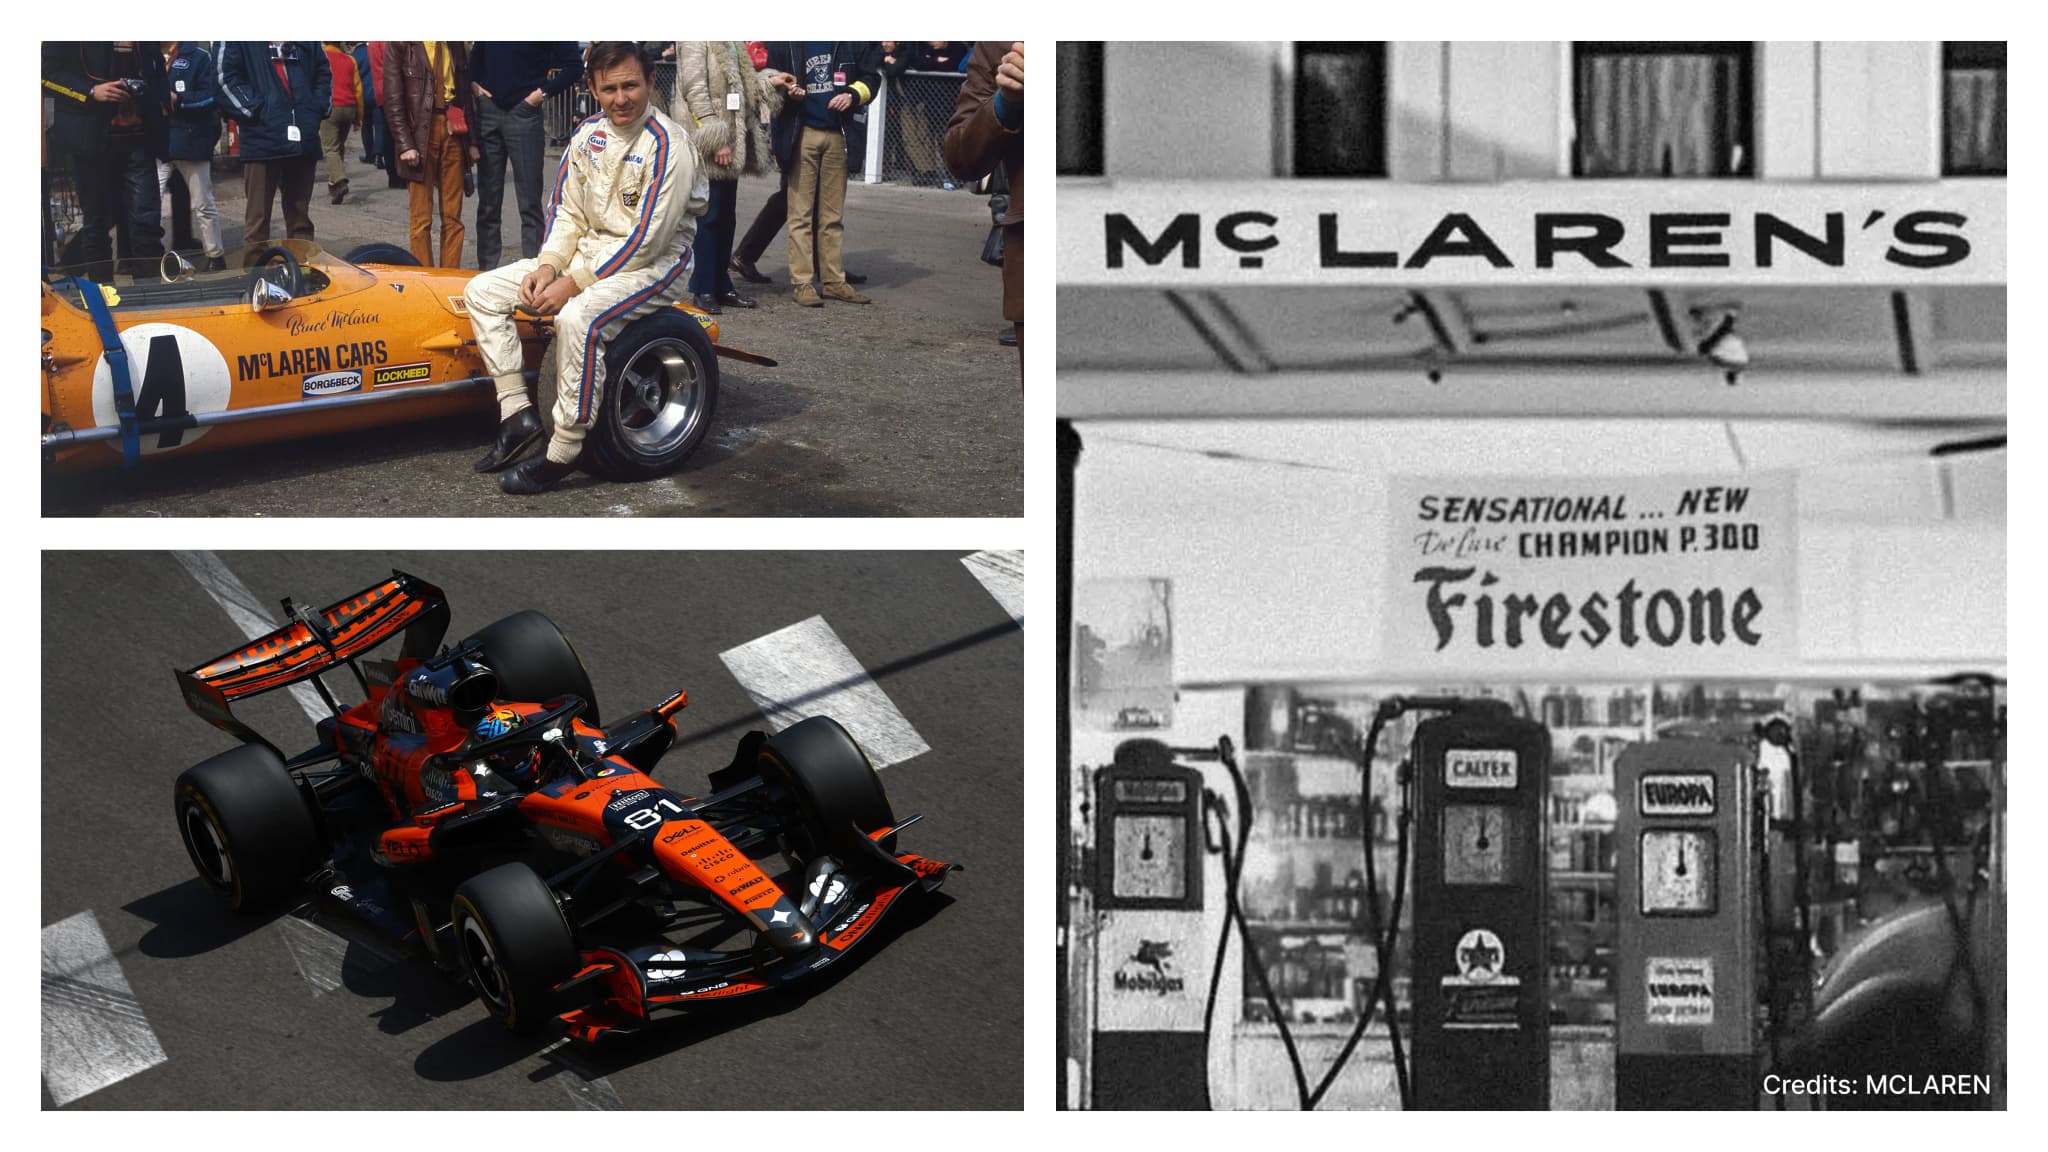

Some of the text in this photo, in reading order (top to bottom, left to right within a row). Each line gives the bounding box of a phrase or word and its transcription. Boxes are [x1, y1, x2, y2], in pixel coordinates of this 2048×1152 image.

[286, 313, 327, 336] Bruce
[337, 340, 388, 370] CARS
[304, 376, 361, 391] BORG&BECK
[376, 367, 429, 383] LOCKHEED
[136, 335, 187, 448] 4
[1418, 495, 1627, 523] SENSATIONAL
[1676, 486, 1750, 517] NEW
[1519, 529, 1669, 558] CHAMPION
[1412, 565, 1763, 652] Firestone
[1453, 760, 1511, 778] CALTEX
[1645, 783, 1713, 806] EUROPA
[624, 798, 682, 830] 81
[662, 825, 702, 843] DELL
[1114, 970, 1184, 997] Mobilgas
[1649, 983, 1711, 998] EUROPA
